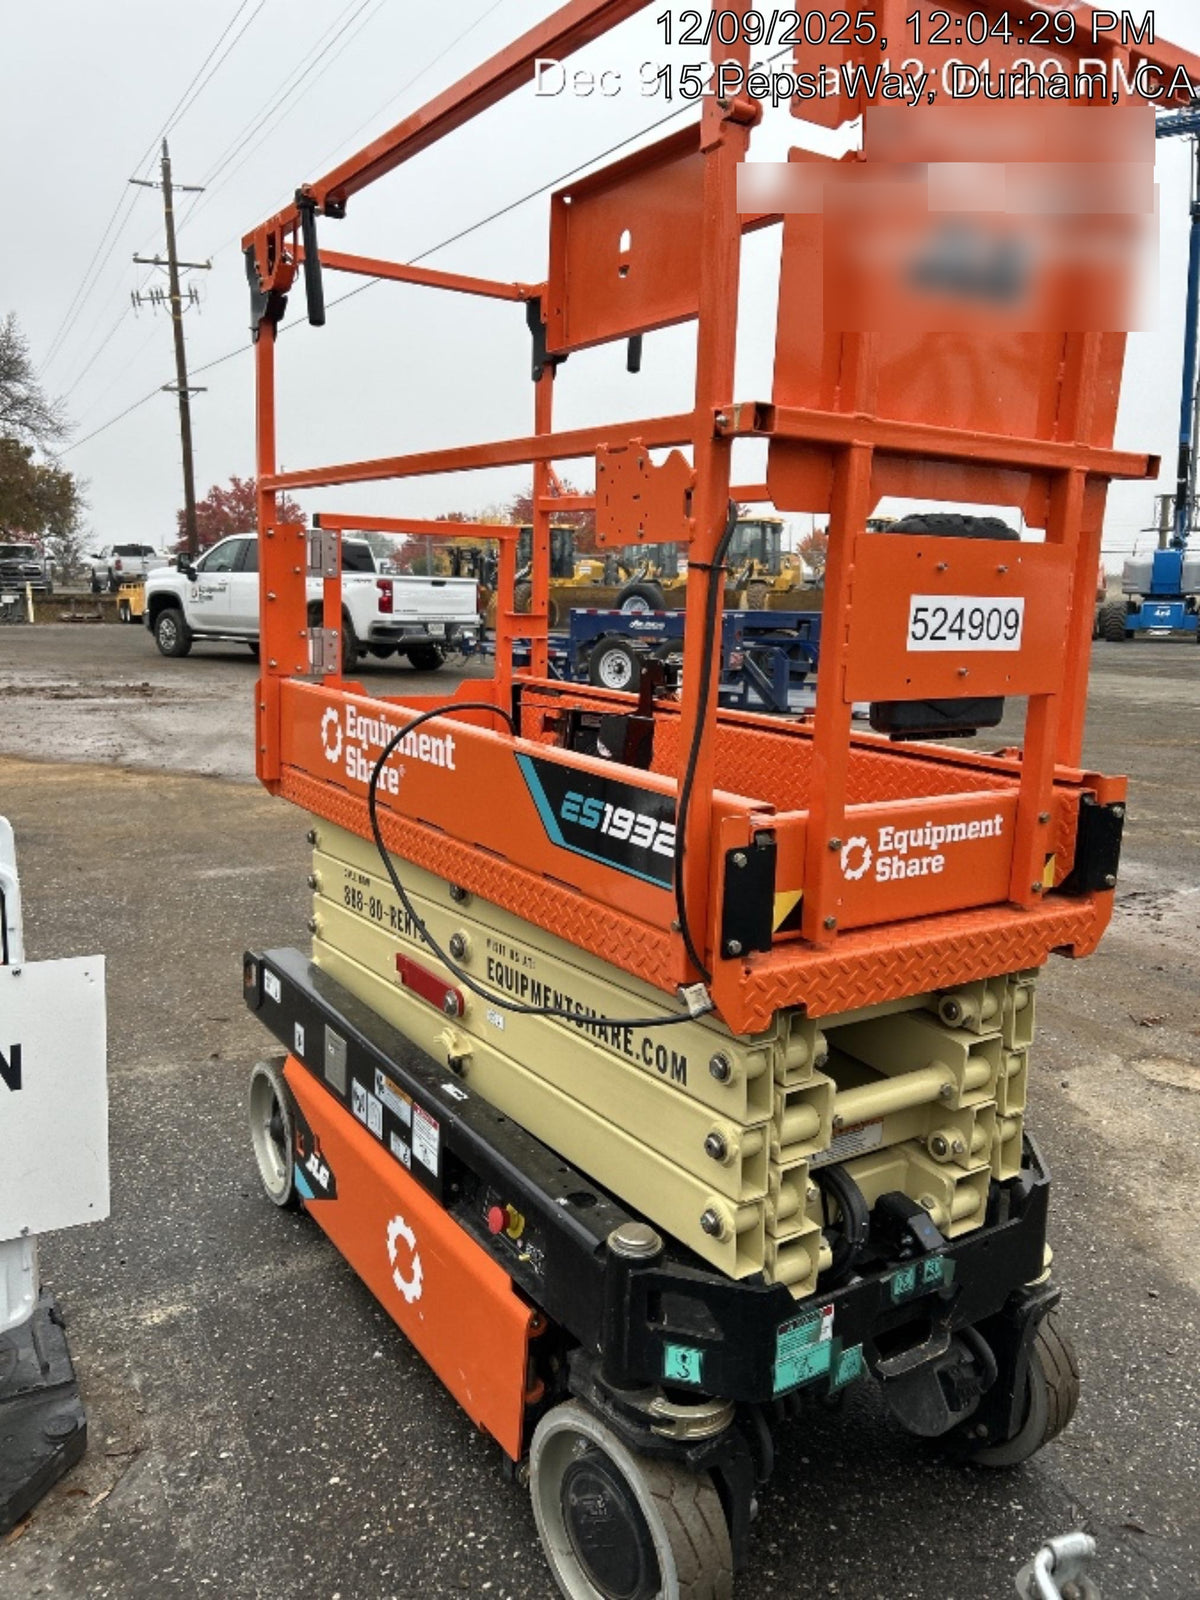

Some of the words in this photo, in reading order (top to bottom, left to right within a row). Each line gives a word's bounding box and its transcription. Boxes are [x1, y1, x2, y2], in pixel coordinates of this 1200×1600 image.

[910, 607, 1020, 642] 524909
[560, 790, 676, 858] ES1932
[877, 813, 1004, 853] Equipment
[875, 853, 945, 883] Share
